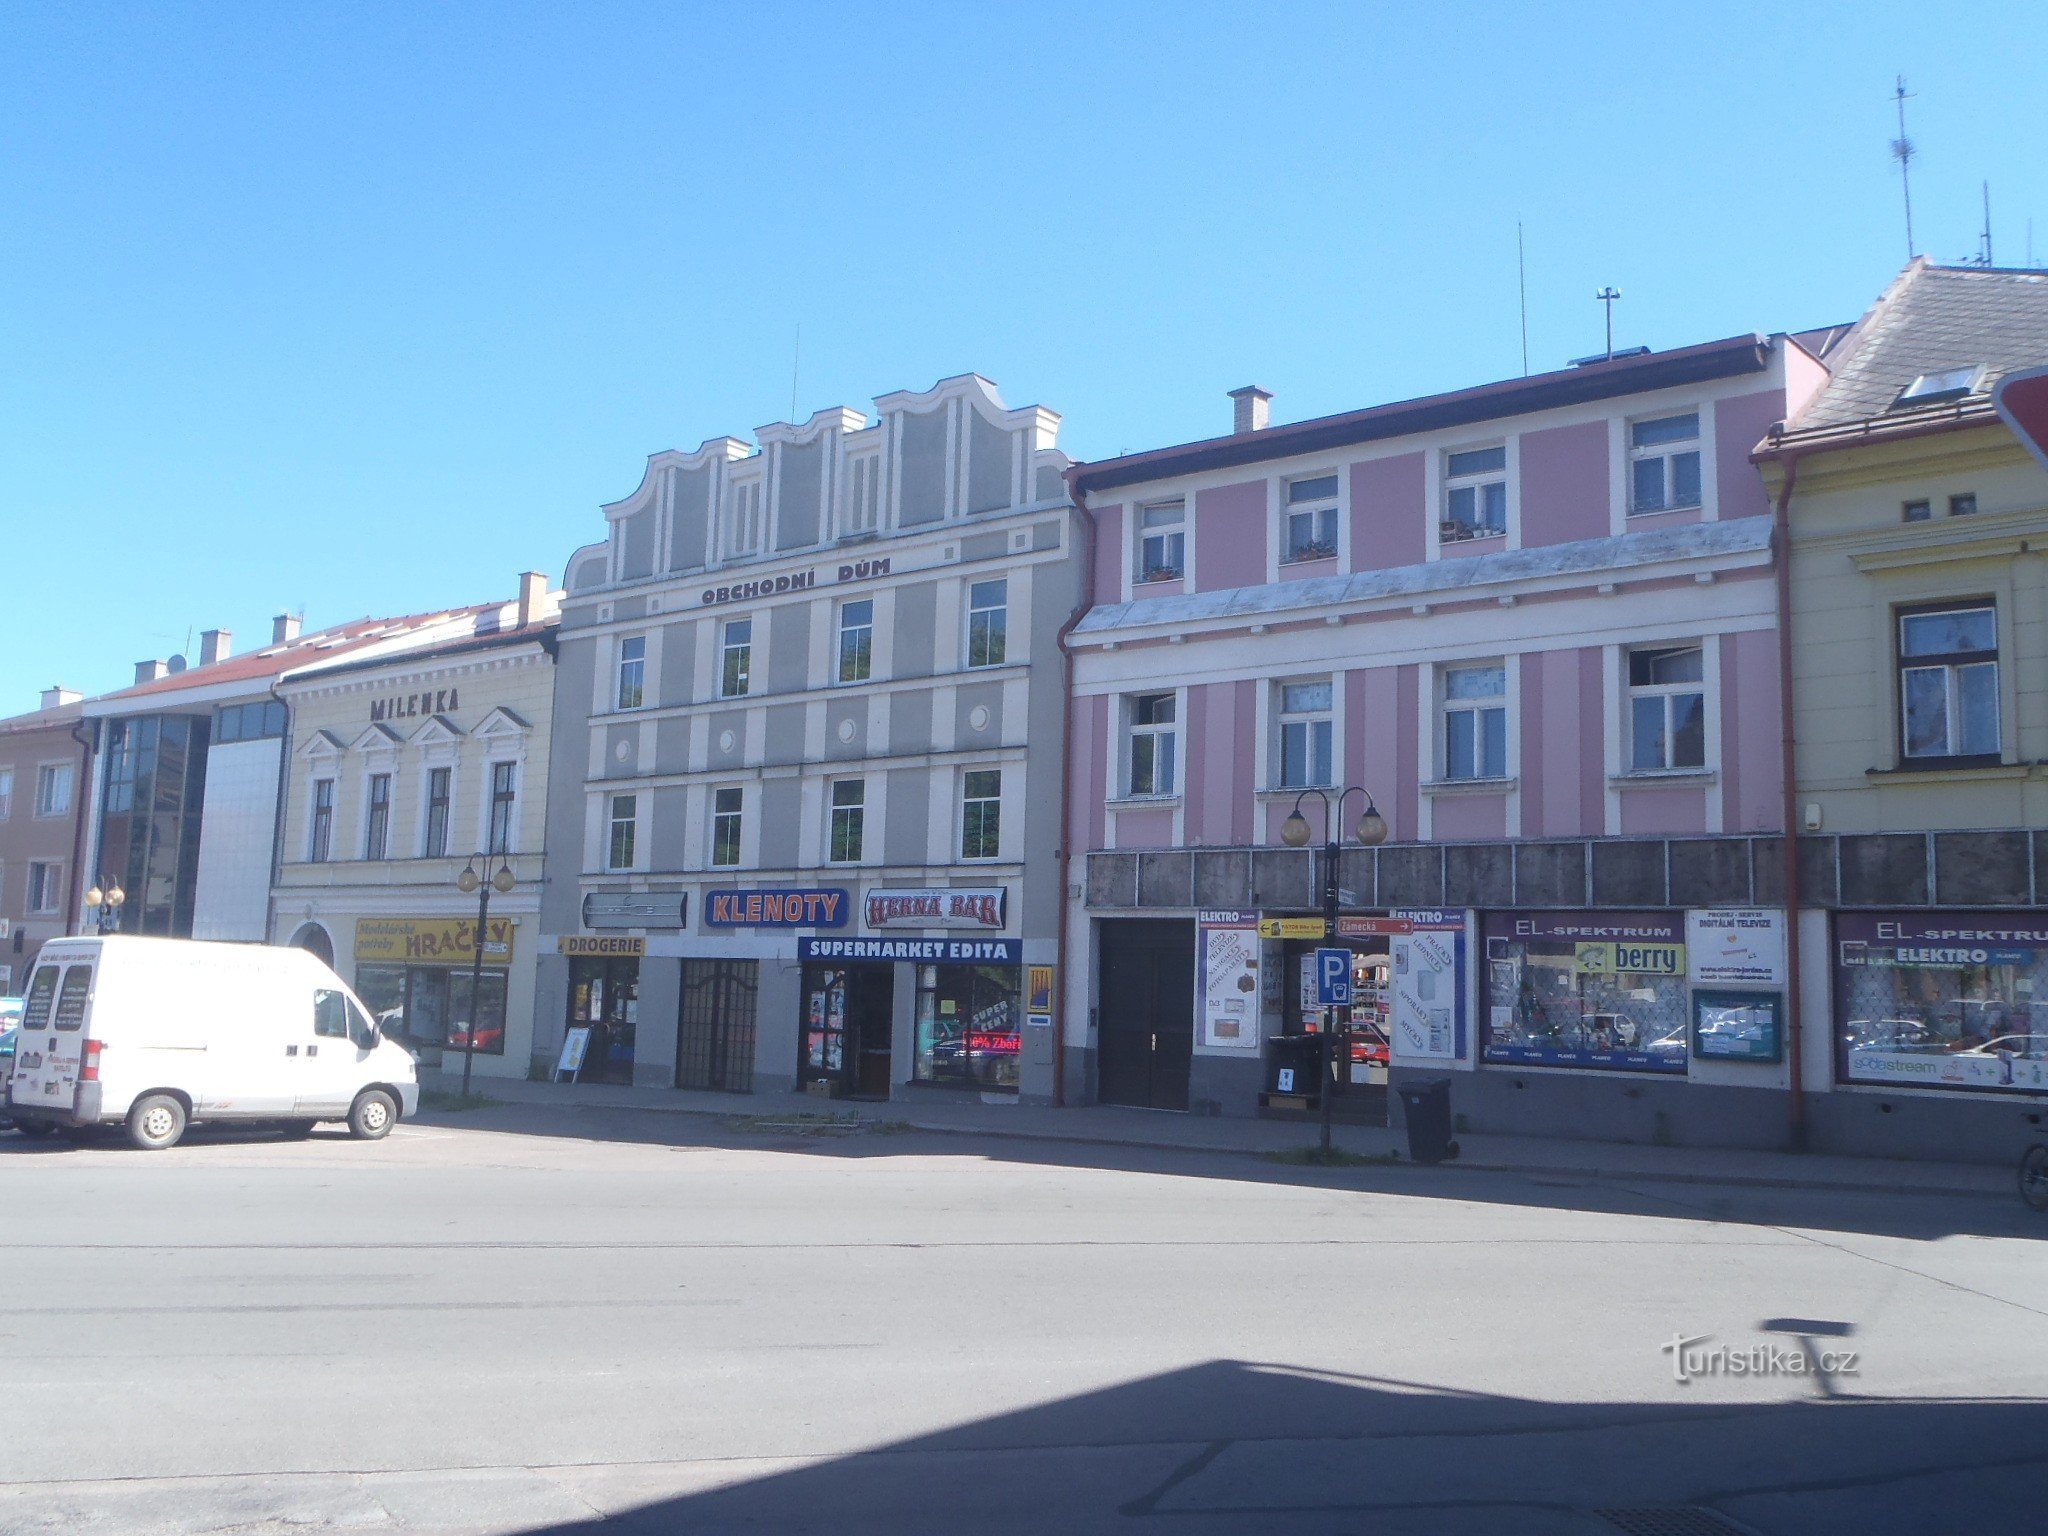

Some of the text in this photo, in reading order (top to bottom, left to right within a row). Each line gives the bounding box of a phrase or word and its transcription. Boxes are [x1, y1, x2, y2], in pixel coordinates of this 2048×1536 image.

[701, 567, 815, 605] OBCHODNÍ
[369, 688, 459, 722] MILENKA
[713, 893, 841, 922] KLENOTY
[867, 894, 1001, 927] HERNA BAR
[1200, 911, 1240, 922] ELEKTRO
[1341, 920, 1376, 932] Zámecká
[1515, 919, 1672, 937] EL-SPEKTRUM
[1699, 918, 1771, 928] DIGITÁLNÍ TELEVIZE
[405, 920, 508, 957] HRAČY
[568, 938, 642, 953] DROGERIE
[810, 940, 1008, 959] SUPERMARKET EDITA
[1208, 933, 1223, 948] DVD
[1208, 933, 1237, 962] TELEVIZE
[1425, 934, 1452, 962] PRAČKY
[1208, 947, 1239, 977] NAVIGACE
[1413, 938, 1440, 967] LEDNICE
[1615, 943, 1676, 974] berry
[1896, 948, 1988, 963] ELEKTRO
[1324, 956, 1345, 988] P
[973, 1000, 1008, 1024] SUPER
[981, 1012, 1008, 1032] CENY
[1854, 1056, 1937, 1074] sodastream
